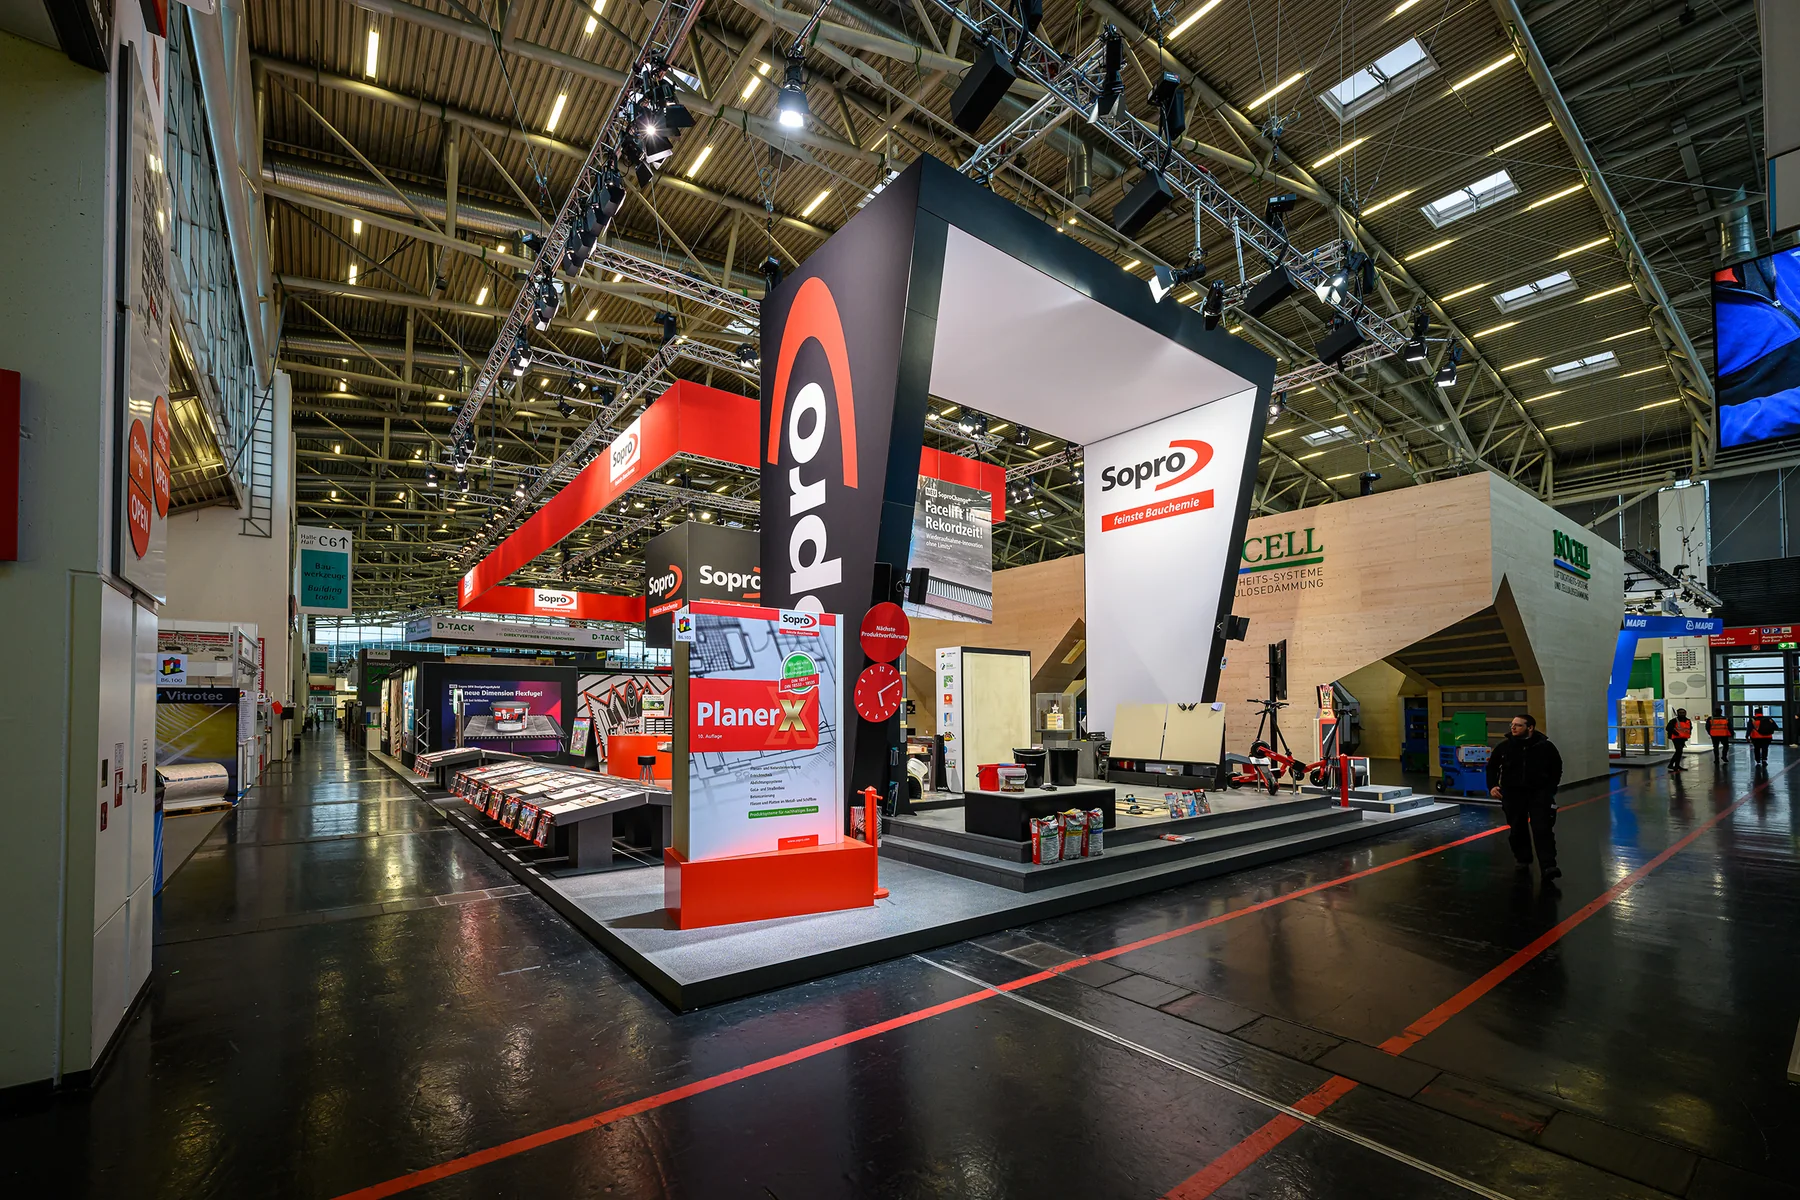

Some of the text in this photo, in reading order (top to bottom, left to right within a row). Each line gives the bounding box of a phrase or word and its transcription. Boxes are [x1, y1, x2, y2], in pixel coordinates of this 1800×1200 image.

[612, 440, 633, 467] Sopro
[1101, 452, 1186, 492] Sopro
[155, 461, 169, 498] OPEN
[926, 488, 937, 497] NEU
[132, 493, 149, 534] OPEN
[925, 500, 976, 523] Facelift in
[1114, 498, 1200, 525] feinste Bauchemie
[925, 516, 983, 539] Rekordzeit!
[301, 533, 337, 548] Halle C6
[1553, 529, 1590, 569] ISOCELL
[315, 562, 335, 570] Bau-
[304, 571, 346, 580] werkzeuge
[700, 565, 760, 592] Sopro
[307, 584, 342, 595] Building
[649, 573, 675, 596] Sopro
[315, 593, 335, 601] tools
[538, 593, 567, 604] Sopro
[783, 614, 810, 625] Sopro
[1626, 619, 1647, 628] MAPEI
[437, 622, 475, 632] D-TACK
[1695, 622, 1714, 630] MAPEI
[592, 634, 620, 642] D-TACK
[861, 631, 908, 641] Produktvorführung
[165, 690, 223, 701] Vitrotec
